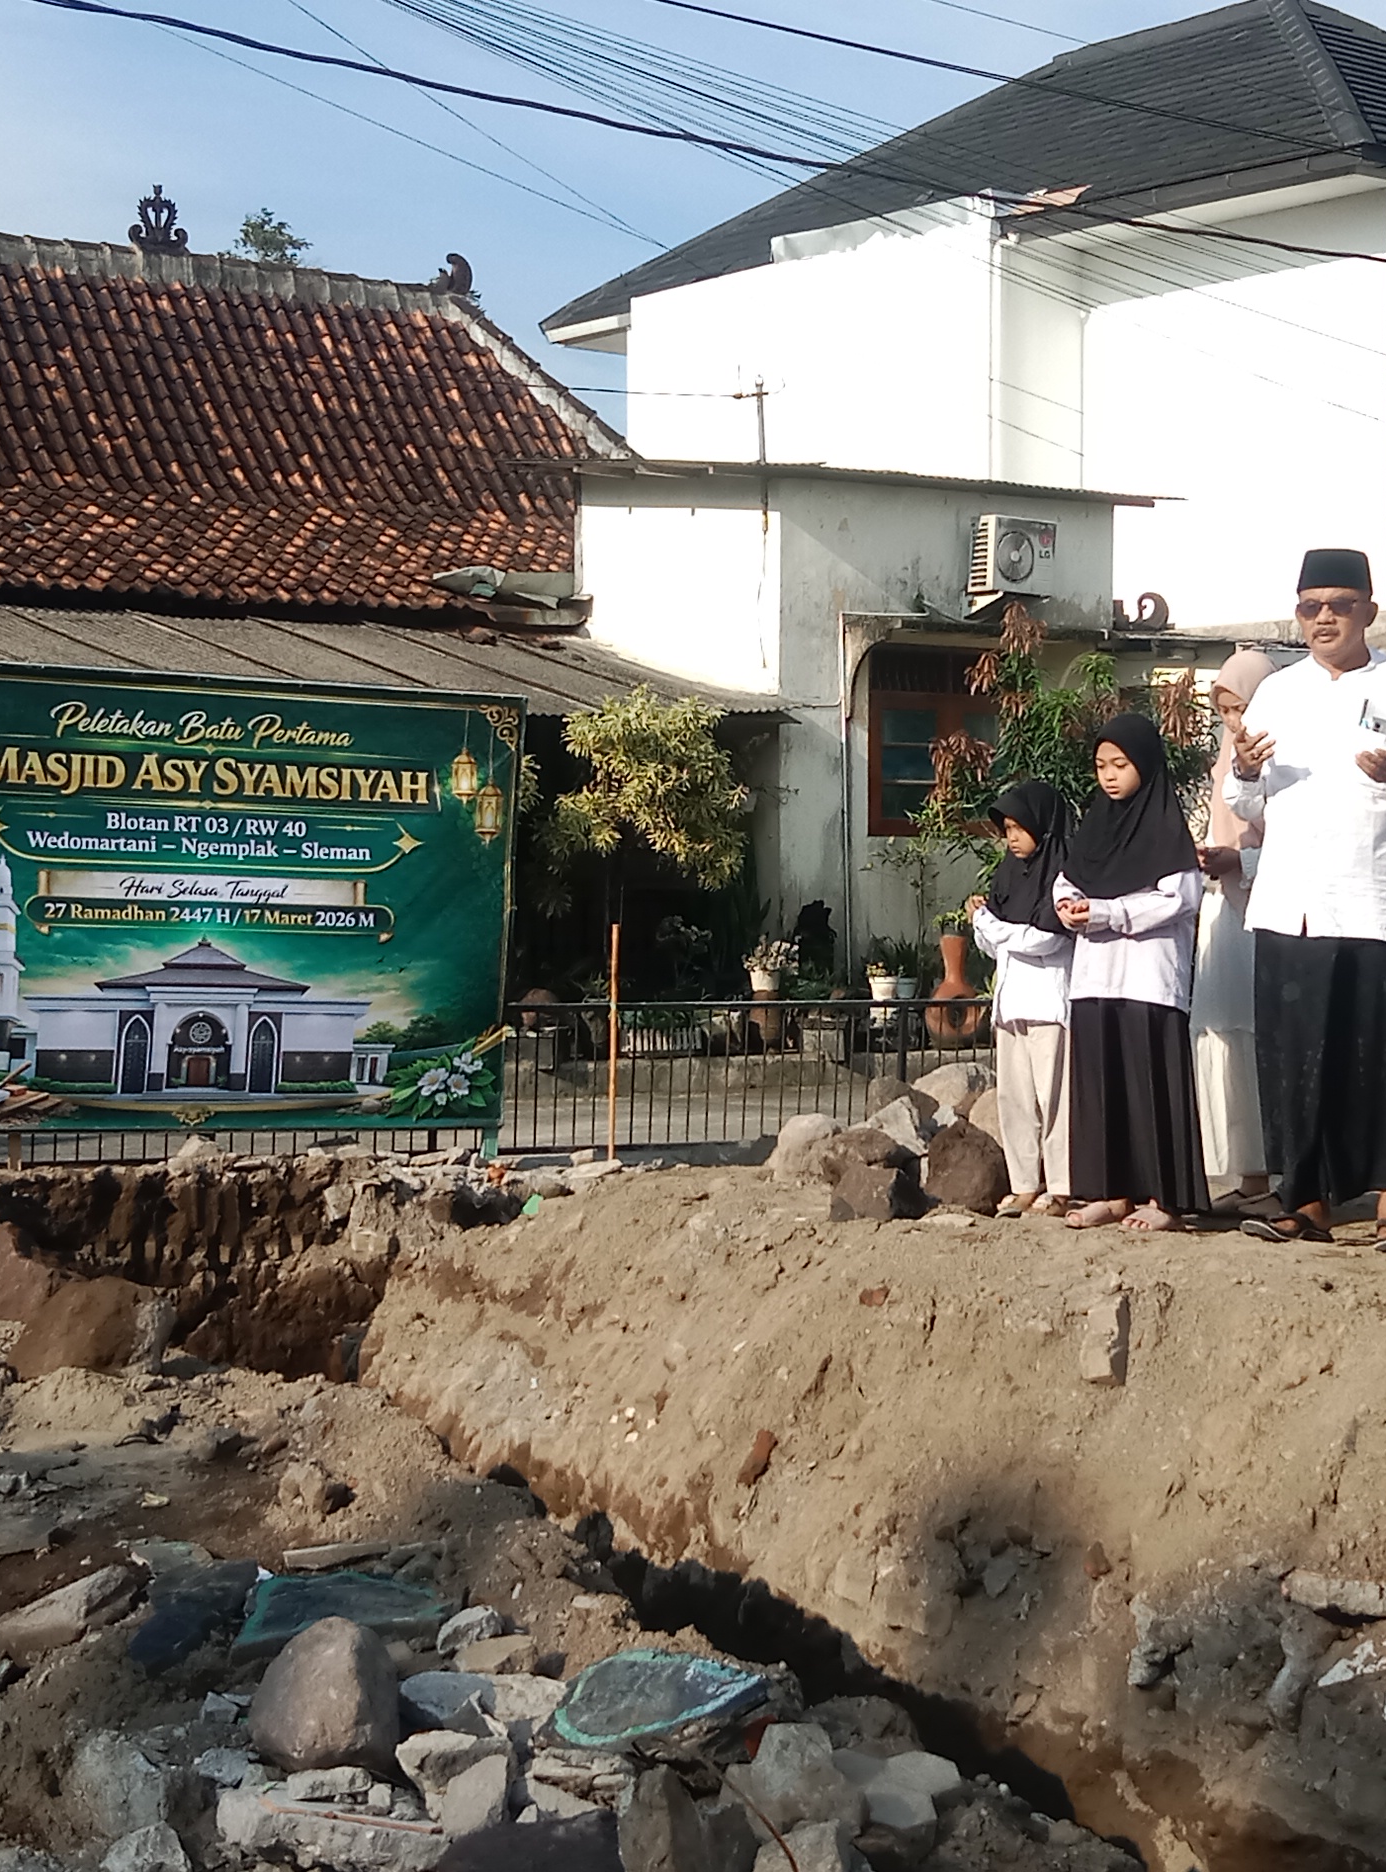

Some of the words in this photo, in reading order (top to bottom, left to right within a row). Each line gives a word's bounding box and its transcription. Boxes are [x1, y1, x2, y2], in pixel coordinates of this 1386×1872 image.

[1039, 550, 1051, 559] LG
[50, 701, 174, 738] Peletakan
[175, 711, 244, 745] Batu
[248, 714, 355, 749] Pertama
[132, 754, 210, 794] ASY
[213, 757, 430, 804] SYAMSIYAH
[106, 812, 169, 832] Blotan
[173, 816, 201, 833] RT
[205, 817, 229, 834] 03
[245, 819, 279, 837] RW
[282, 821, 307, 838] 40
[26, 831, 157, 853] Wedomartani
[181, 839, 279, 860] Ngemplak
[301, 842, 371, 862] Sleman
[119, 876, 164, 897] Hari
[225, 880, 289, 906] Tanggal
[44, 903, 67, 919] 27
[70, 904, 165, 921] Ramadhan
[170, 907, 213, 923] 2447
[216, 908, 231, 924] H
[243, 909, 260, 924] 17
[264, 909, 313, 925] Maret
[315, 910, 356, 927] 2026
[359, 912, 375, 927] M
